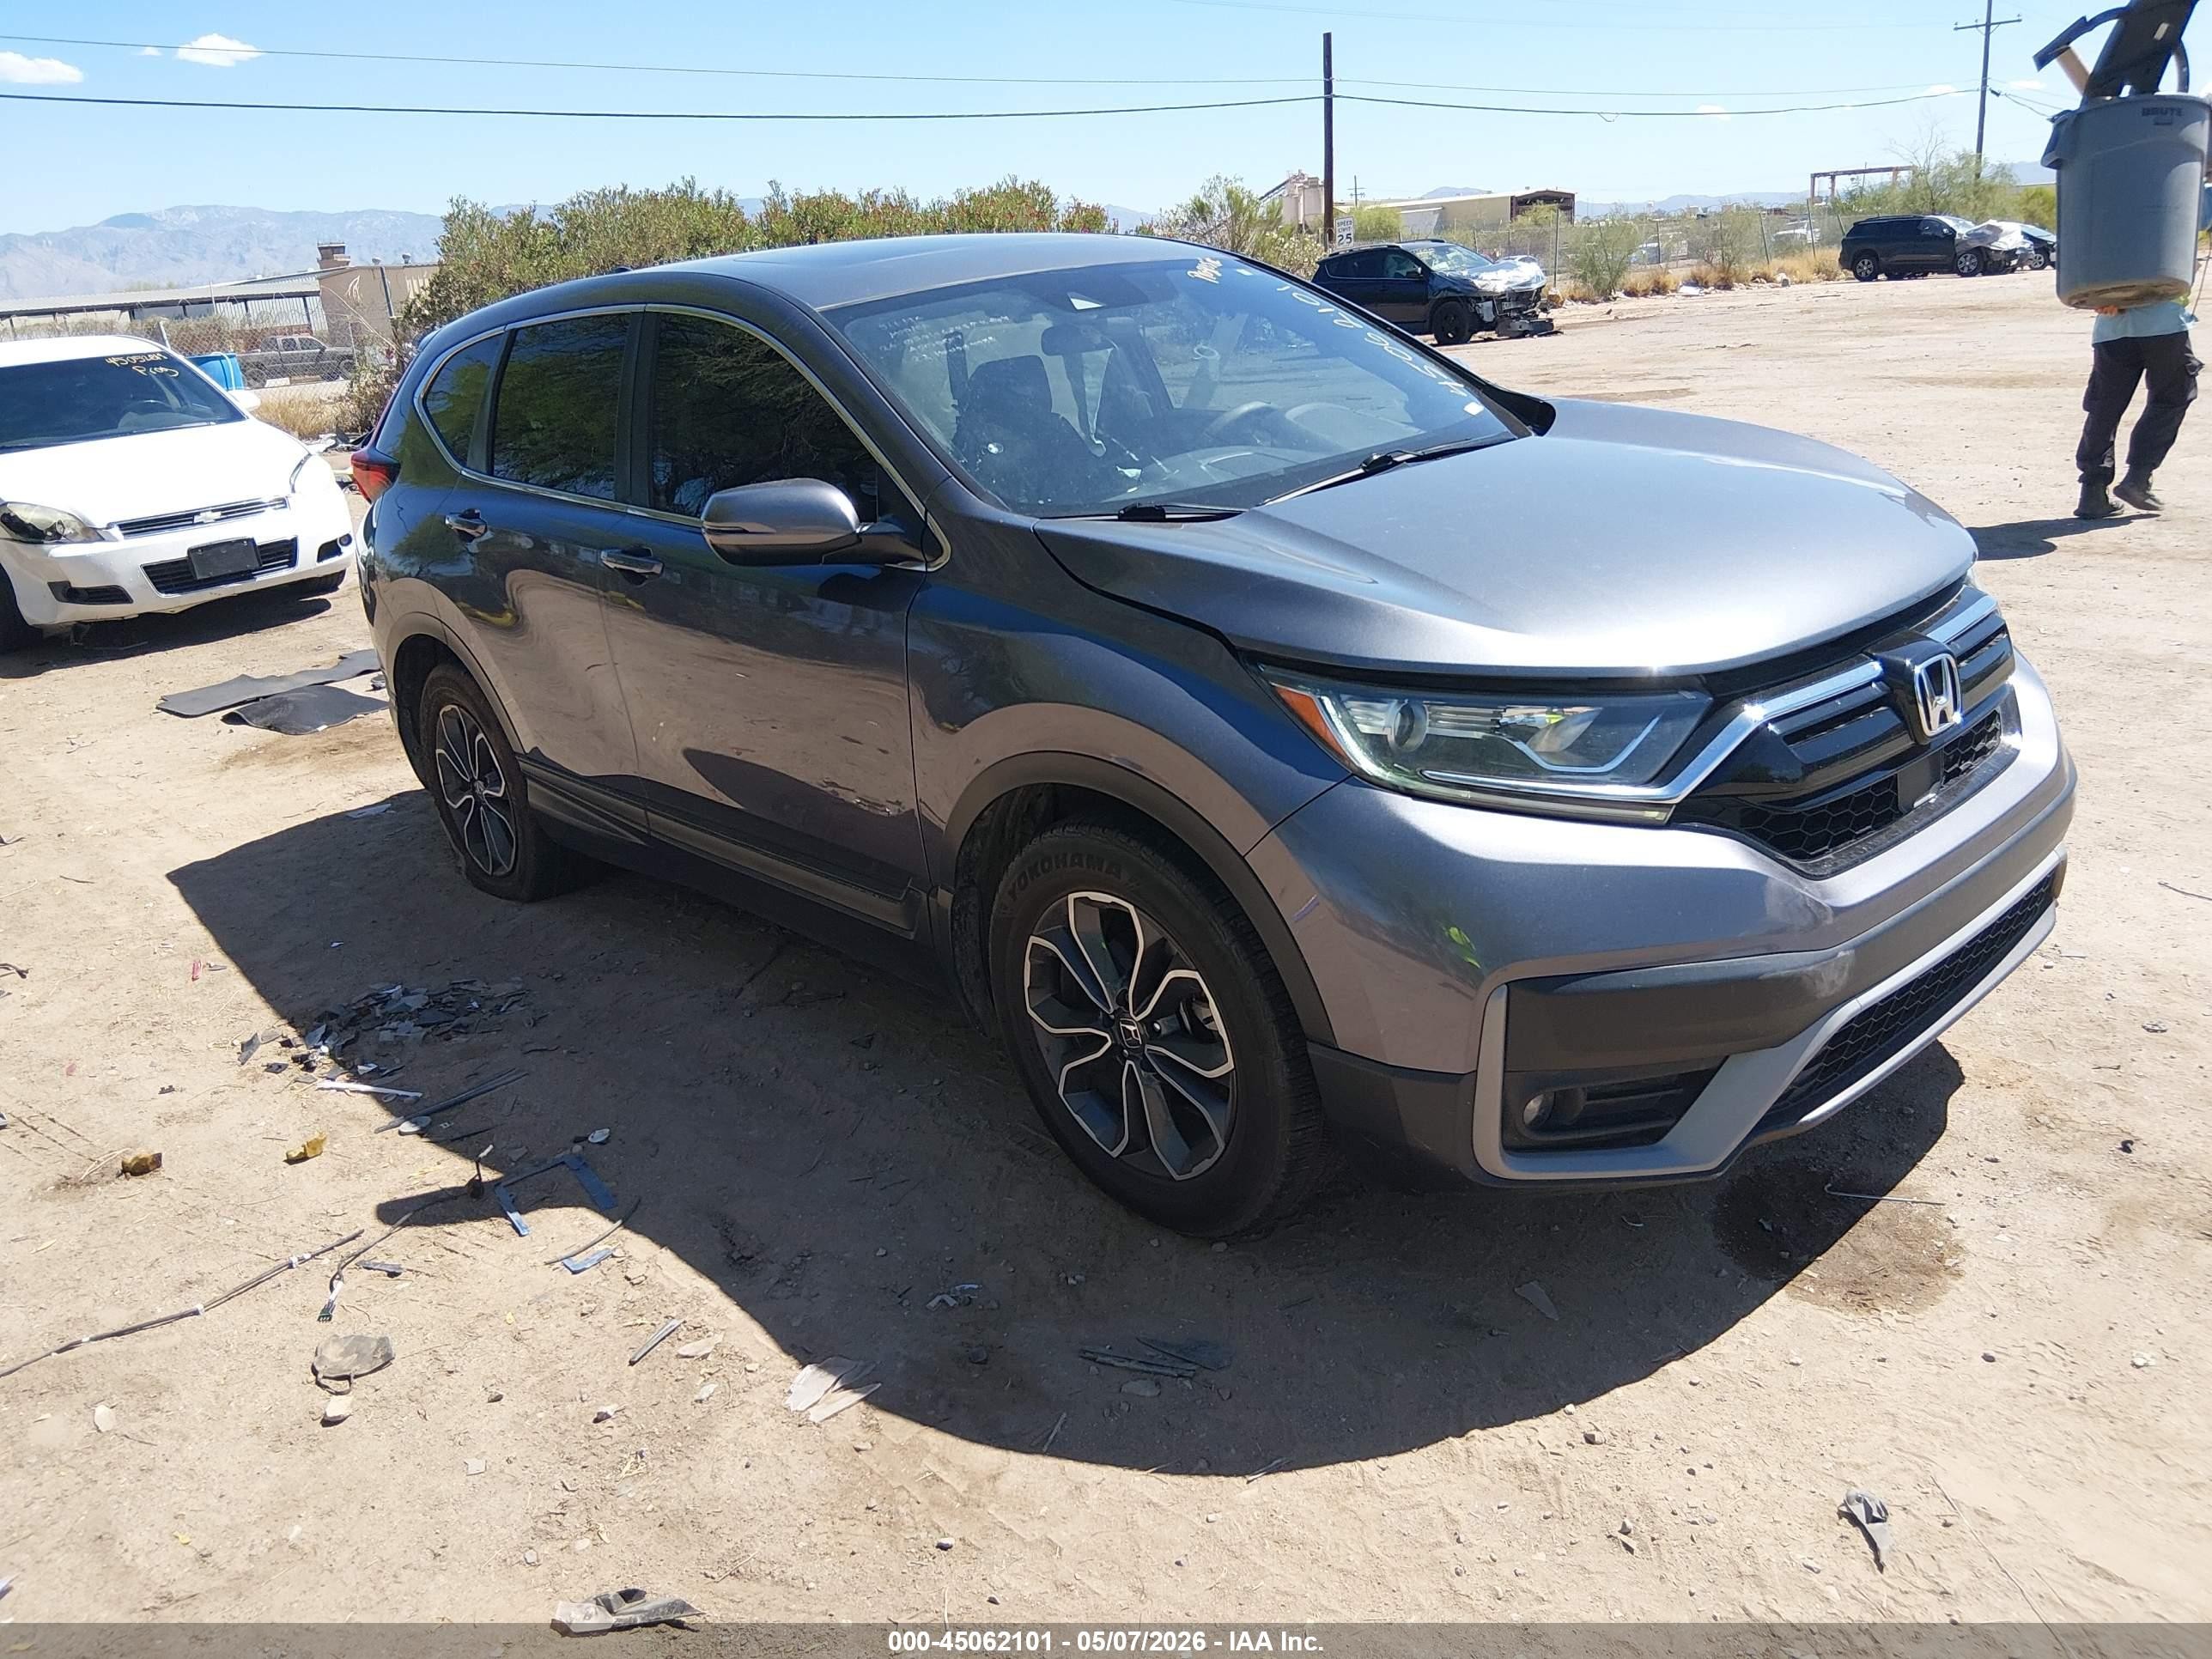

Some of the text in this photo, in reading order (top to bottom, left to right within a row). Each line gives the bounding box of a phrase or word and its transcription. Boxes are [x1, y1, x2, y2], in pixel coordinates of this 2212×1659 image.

[2142, 107, 2184, 117] BRUTE
[1337, 233, 1352, 246] 25
[1008, 852, 1123, 901] YOKOHAMA
